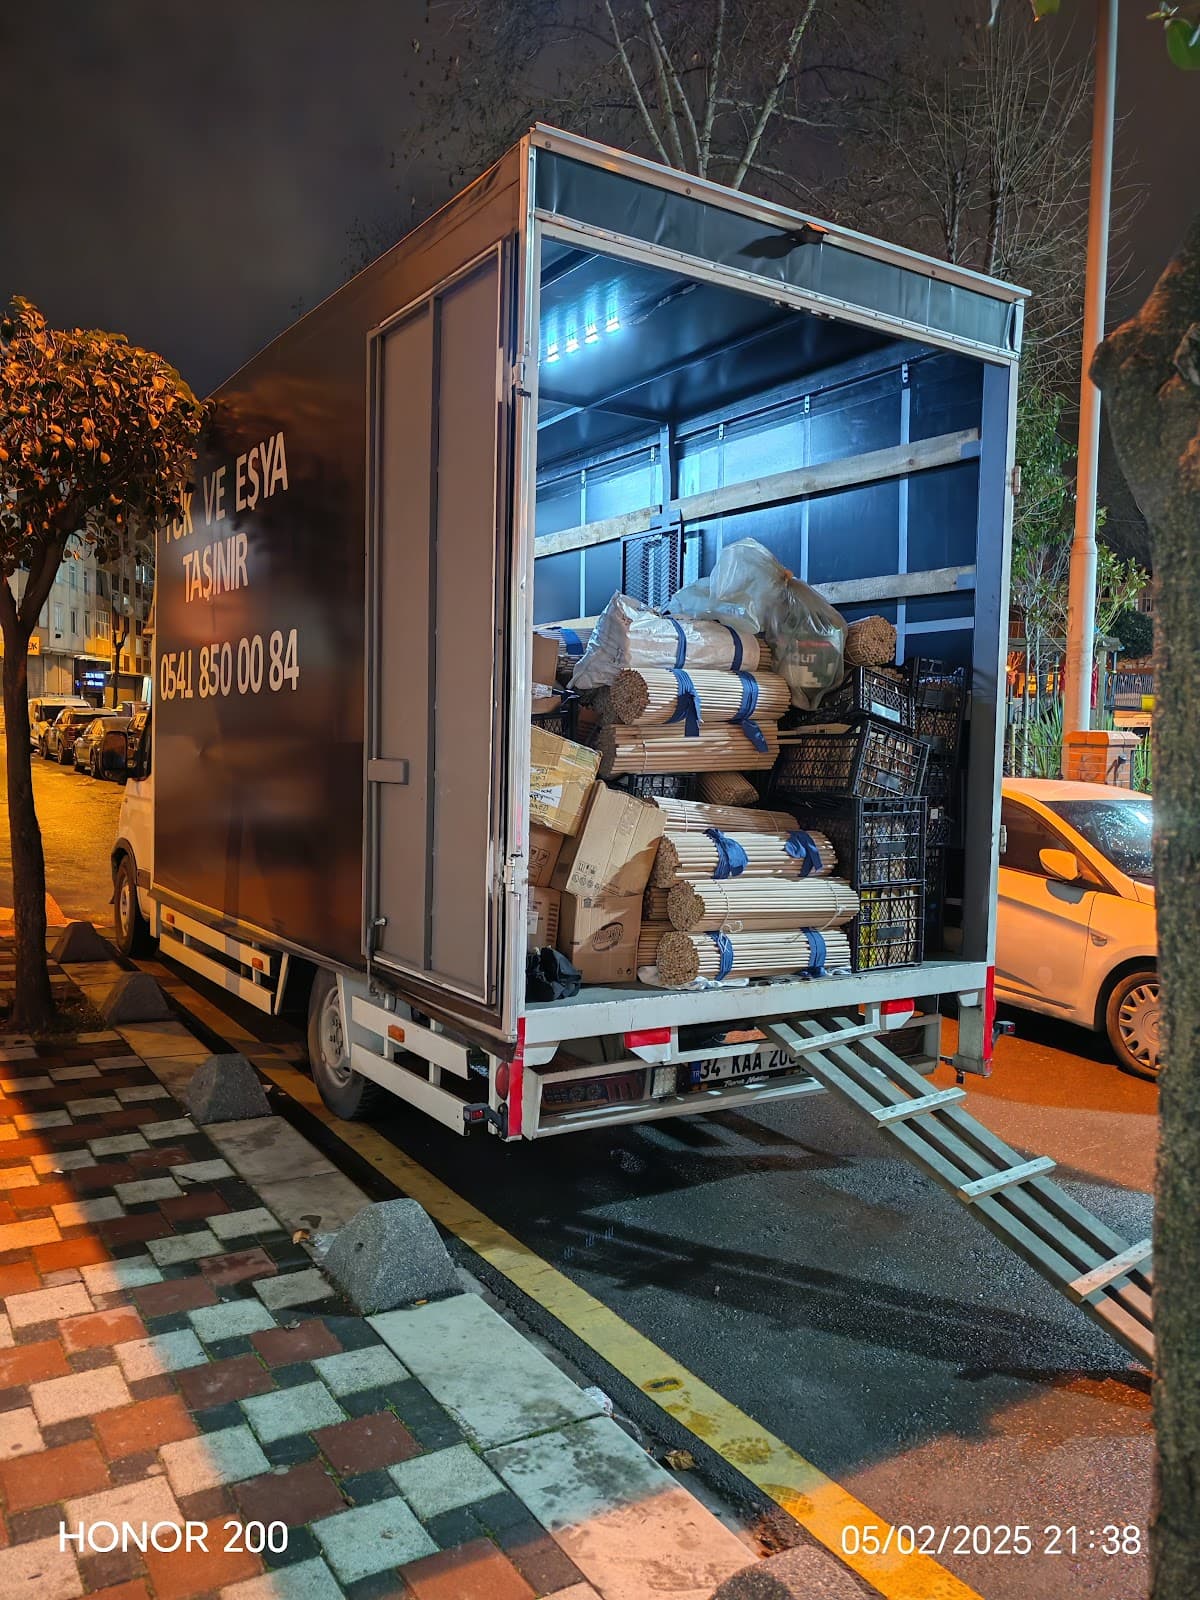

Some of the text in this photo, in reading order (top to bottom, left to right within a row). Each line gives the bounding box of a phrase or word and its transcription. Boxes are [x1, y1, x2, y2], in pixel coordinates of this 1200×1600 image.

[203, 465, 227, 526] VE
[235, 431, 288, 511] EŞYA
[183, 532, 249, 603] TAŞINIR
[160, 628, 299, 701] 0541 850 00 84
[700, 1058, 721, 1079] 34
[731, 1053, 762, 1075] KAA
